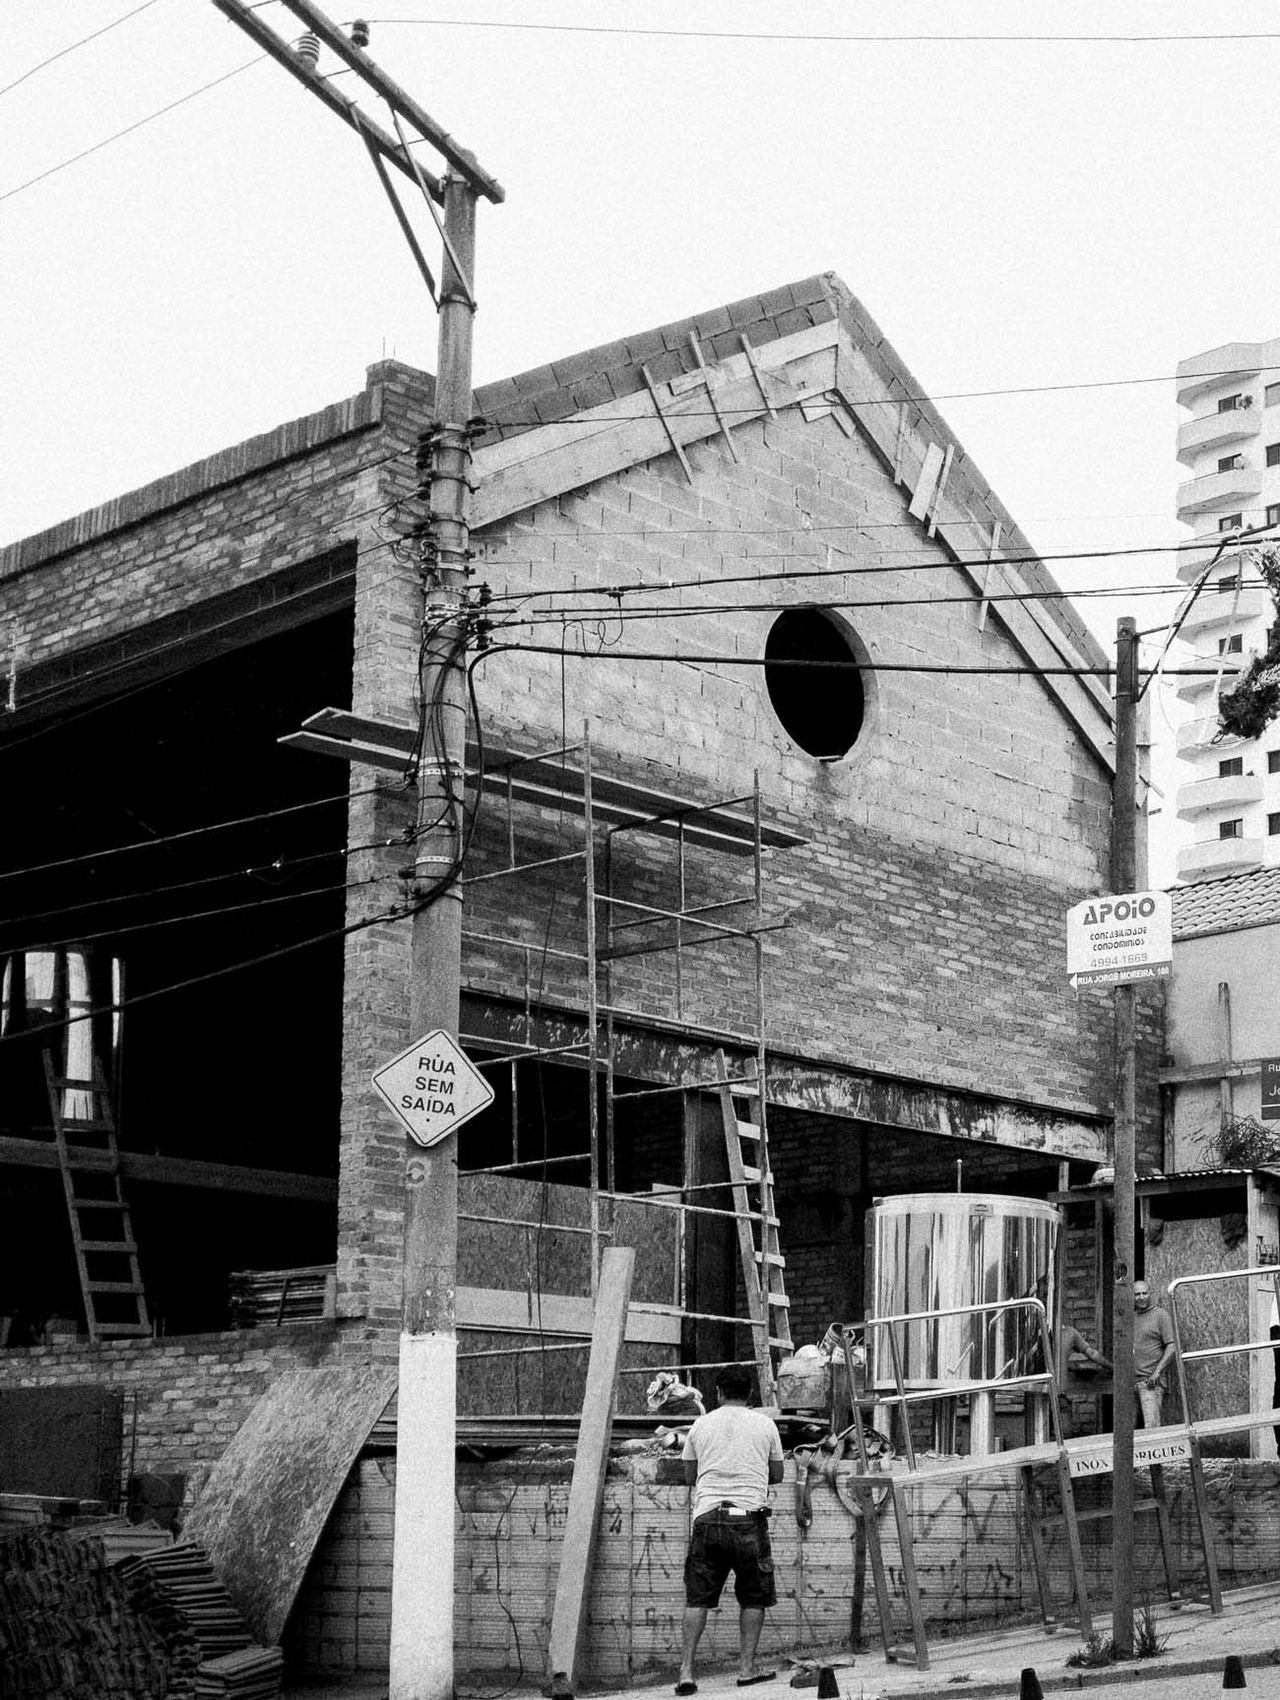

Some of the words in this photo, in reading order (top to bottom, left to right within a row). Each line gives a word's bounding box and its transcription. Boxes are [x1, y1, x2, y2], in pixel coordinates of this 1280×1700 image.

[1077, 976, 1094, 986] RUA
[1094, 972, 1119, 984] JORGE
[418, 1056, 456, 1076] RUA
[415, 1076, 454, 1095] SEM
[401, 1094, 456, 1116] SAÍDA
[1076, 1459, 1109, 1473] INOX
